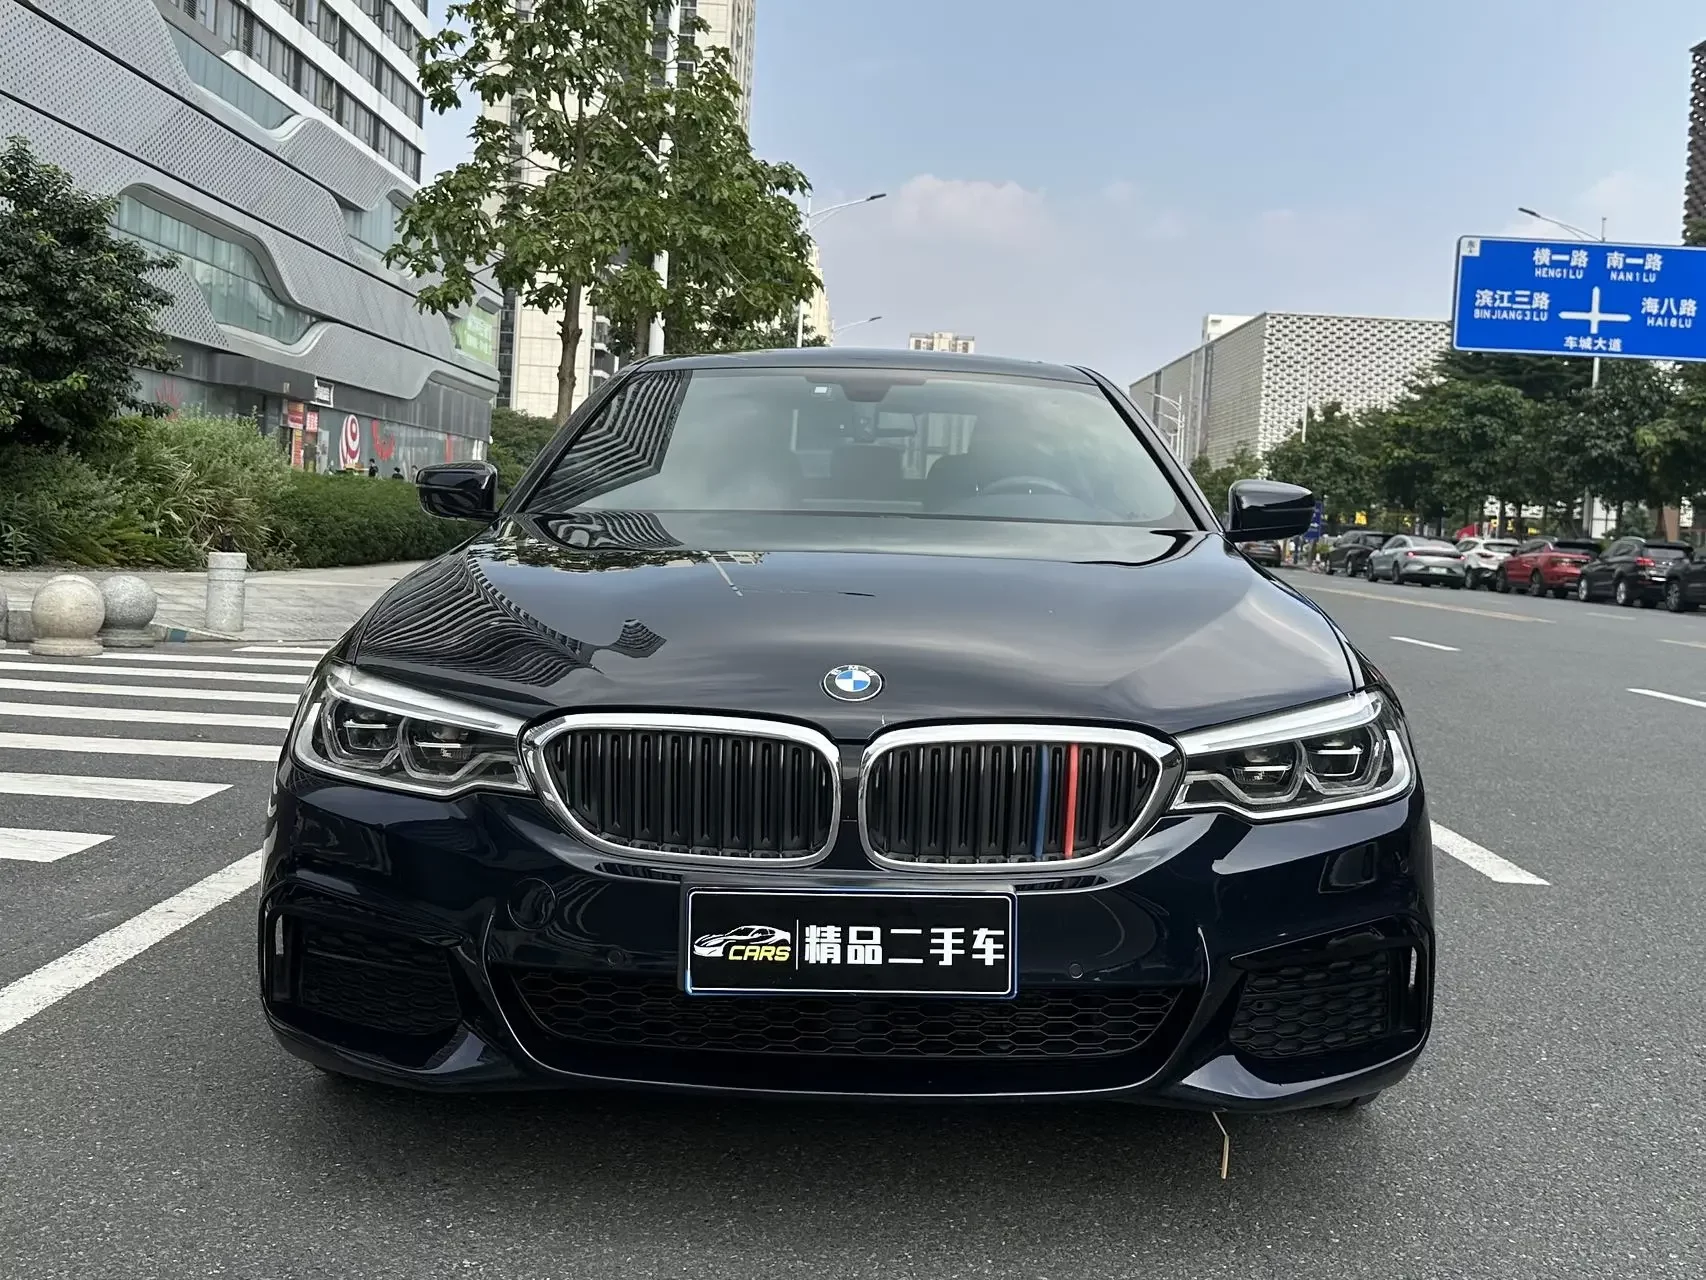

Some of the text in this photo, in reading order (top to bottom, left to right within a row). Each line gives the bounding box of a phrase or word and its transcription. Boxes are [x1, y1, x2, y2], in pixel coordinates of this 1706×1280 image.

[1533, 247, 1588, 268] 横一路
[1606, 250, 1663, 271] 南一路
[1475, 289, 1549, 310] 滨江三路
[1641, 297, 1697, 317] 海八路
[1563, 336, 1622, 352] 车城大道
[728, 944, 791, 961] CARS
[805, 924, 1005, 966] 精品二手车
